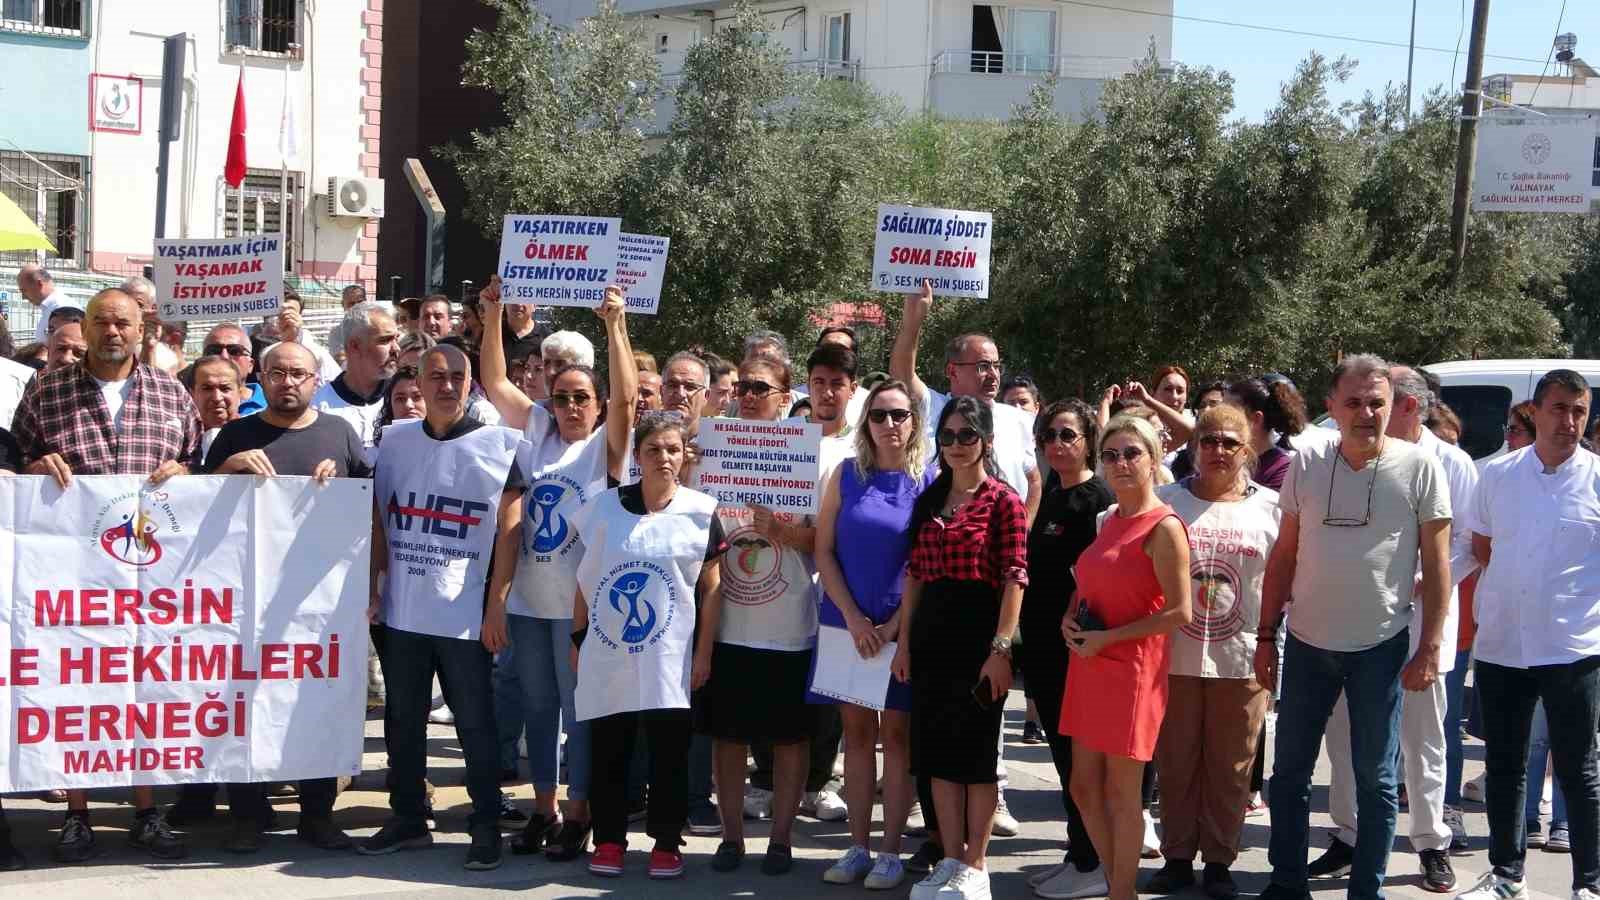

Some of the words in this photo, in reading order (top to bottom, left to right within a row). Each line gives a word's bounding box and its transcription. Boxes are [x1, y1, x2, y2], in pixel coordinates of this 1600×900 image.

[1510, 183, 1556, 192] YALINAYAK
[1480, 193, 1517, 203] SAĞLIKLI
[1518, 194, 1545, 203] HAYAT
[1546, 193, 1584, 203] MERKEZİ
[513, 219, 609, 237] YAŞATIRKEN
[881, 212, 942, 236] SAĞLIKTA
[944, 214, 987, 241] ŞİDDET
[157, 243, 243, 260] YAŞATMAK
[246, 237, 278, 256] İÇİN
[524, 239, 589, 261] ÖLMEK
[889, 246, 931, 266] SONA
[934, 246, 977, 268] ERSİN
[174, 259, 263, 280] YAŞAMAK
[503, 260, 609, 282] İSTEMİYORUZ
[895, 275, 912, 287] SES
[173, 281, 267, 299] İSTİYORUZ
[517, 286, 533, 298] SES
[536, 286, 572, 299] MERSİN
[574, 288, 605, 301] ŞUBES
[180, 304, 200, 315] SES
[202, 300, 240, 314] MERSİN
[714, 423, 724, 432] NE
[725, 422, 751, 433] SAĞLIK
[752, 424, 804, 436] EMEKÇİLERİNE
[726, 436, 758, 446] YÖNELİK
[720, 450, 758, 460] TOPLUMDA
[760, 450, 786, 461] KÜLTÜR
[789, 453, 816, 464] HALİNE
[721, 461, 753, 471] GELMEYE
[754, 463, 792, 473] BAŞLAYAN
[700, 472, 732, 485] ŞİDDETİ
[733, 477, 762, 487] KABUL
[762, 478, 815, 490] ETMİYORUZ!
[718, 490, 734, 502] SES
[736, 490, 774, 505] MERSİN
[387, 490, 489, 540] AHEF
[1189, 527, 1243, 540] MERSİN
[427, 545, 480, 560] DERNEKLERİ
[1216, 543, 1258, 558] ODASI
[535, 555, 553, 563] SES
[407, 566, 426, 576] 2008
[34, 579, 233, 627] MERSİN
[60, 634, 339, 684] HEKİMLERİ
[18, 692, 246, 744] DERNEĞİ
[64, 746, 205, 774] MAHDER
